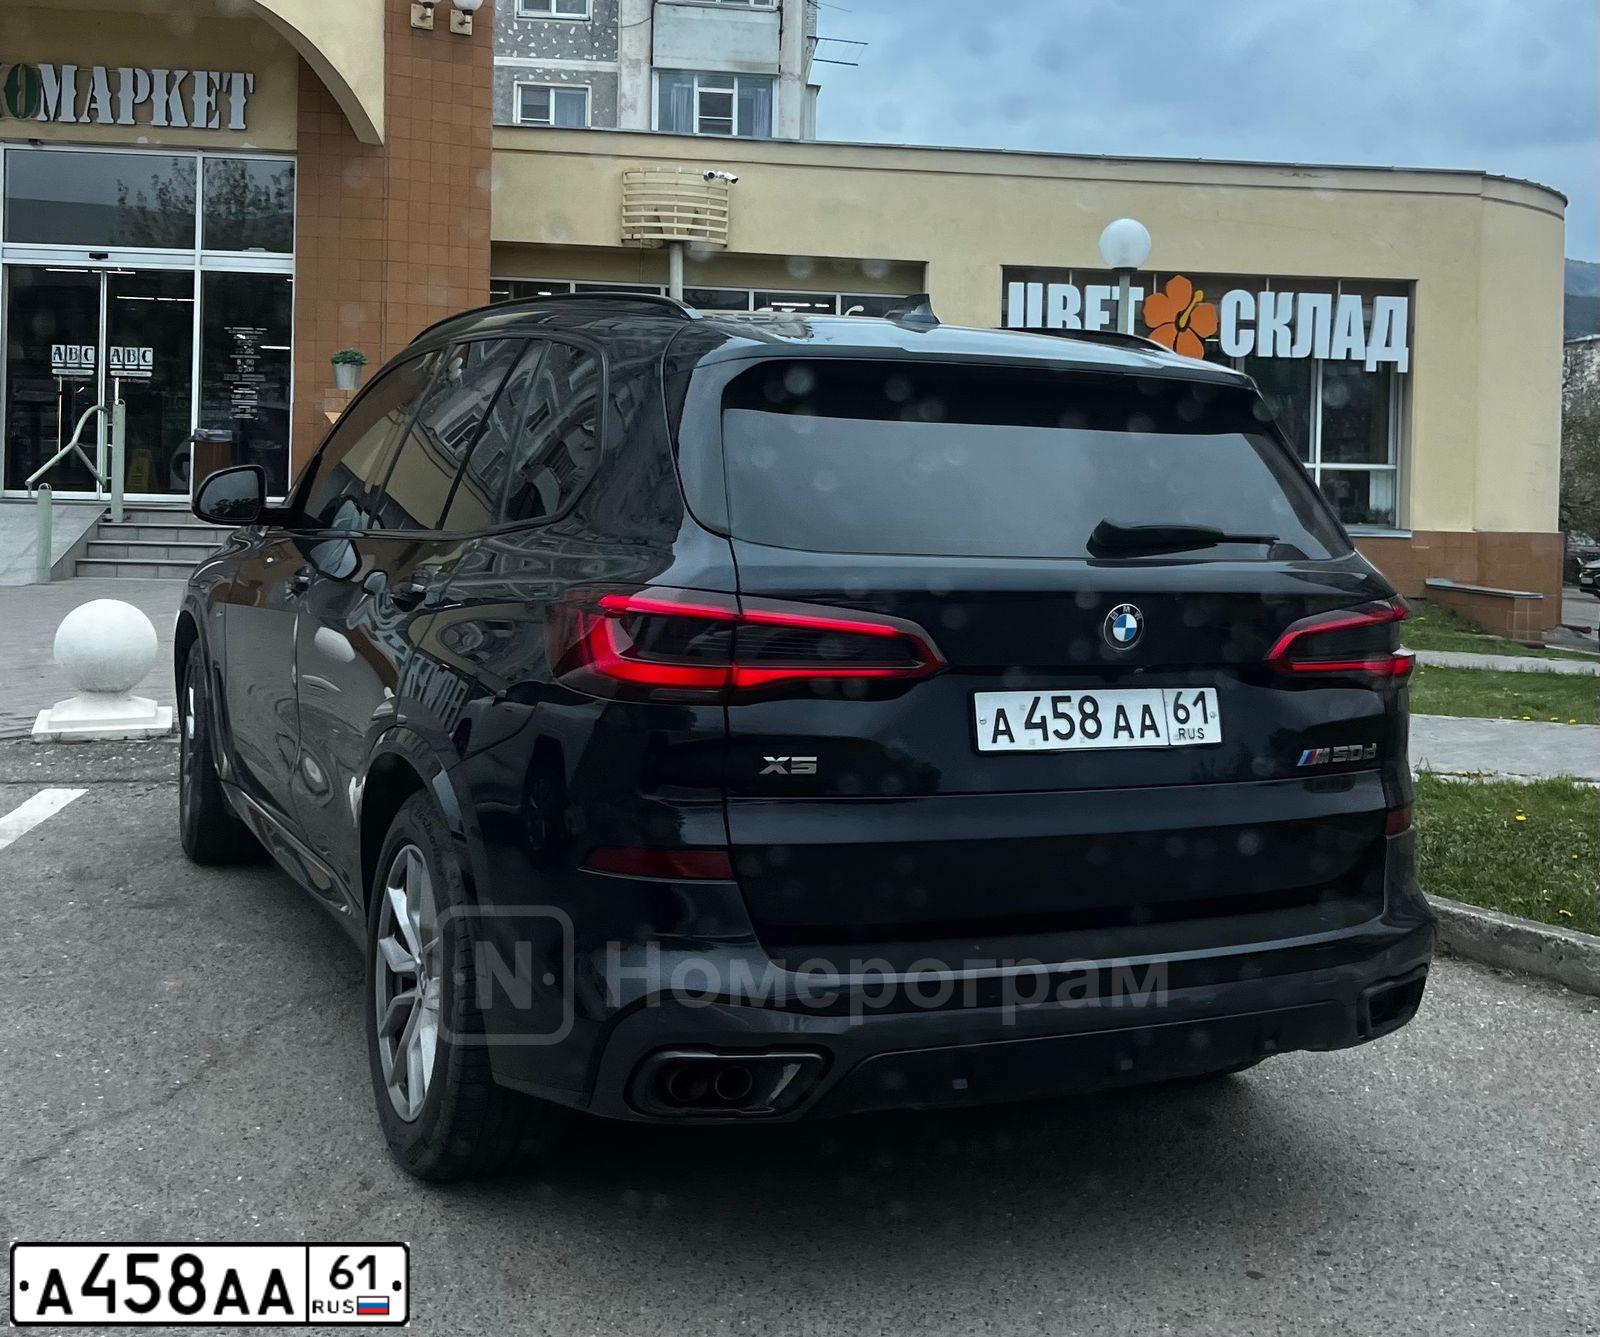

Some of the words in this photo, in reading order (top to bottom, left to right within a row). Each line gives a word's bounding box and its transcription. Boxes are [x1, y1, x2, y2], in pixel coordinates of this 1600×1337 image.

[0, 63, 256, 131] ОМАРКЕТ
[1218, 288, 1409, 373] СКЛАД
[52, 345, 94, 363] ABC
[110, 347, 153, 365] ABC
[1173, 690, 1208, 725] 61
[1177, 727, 1205, 740] RUS
[759, 756, 817, 774] X5
